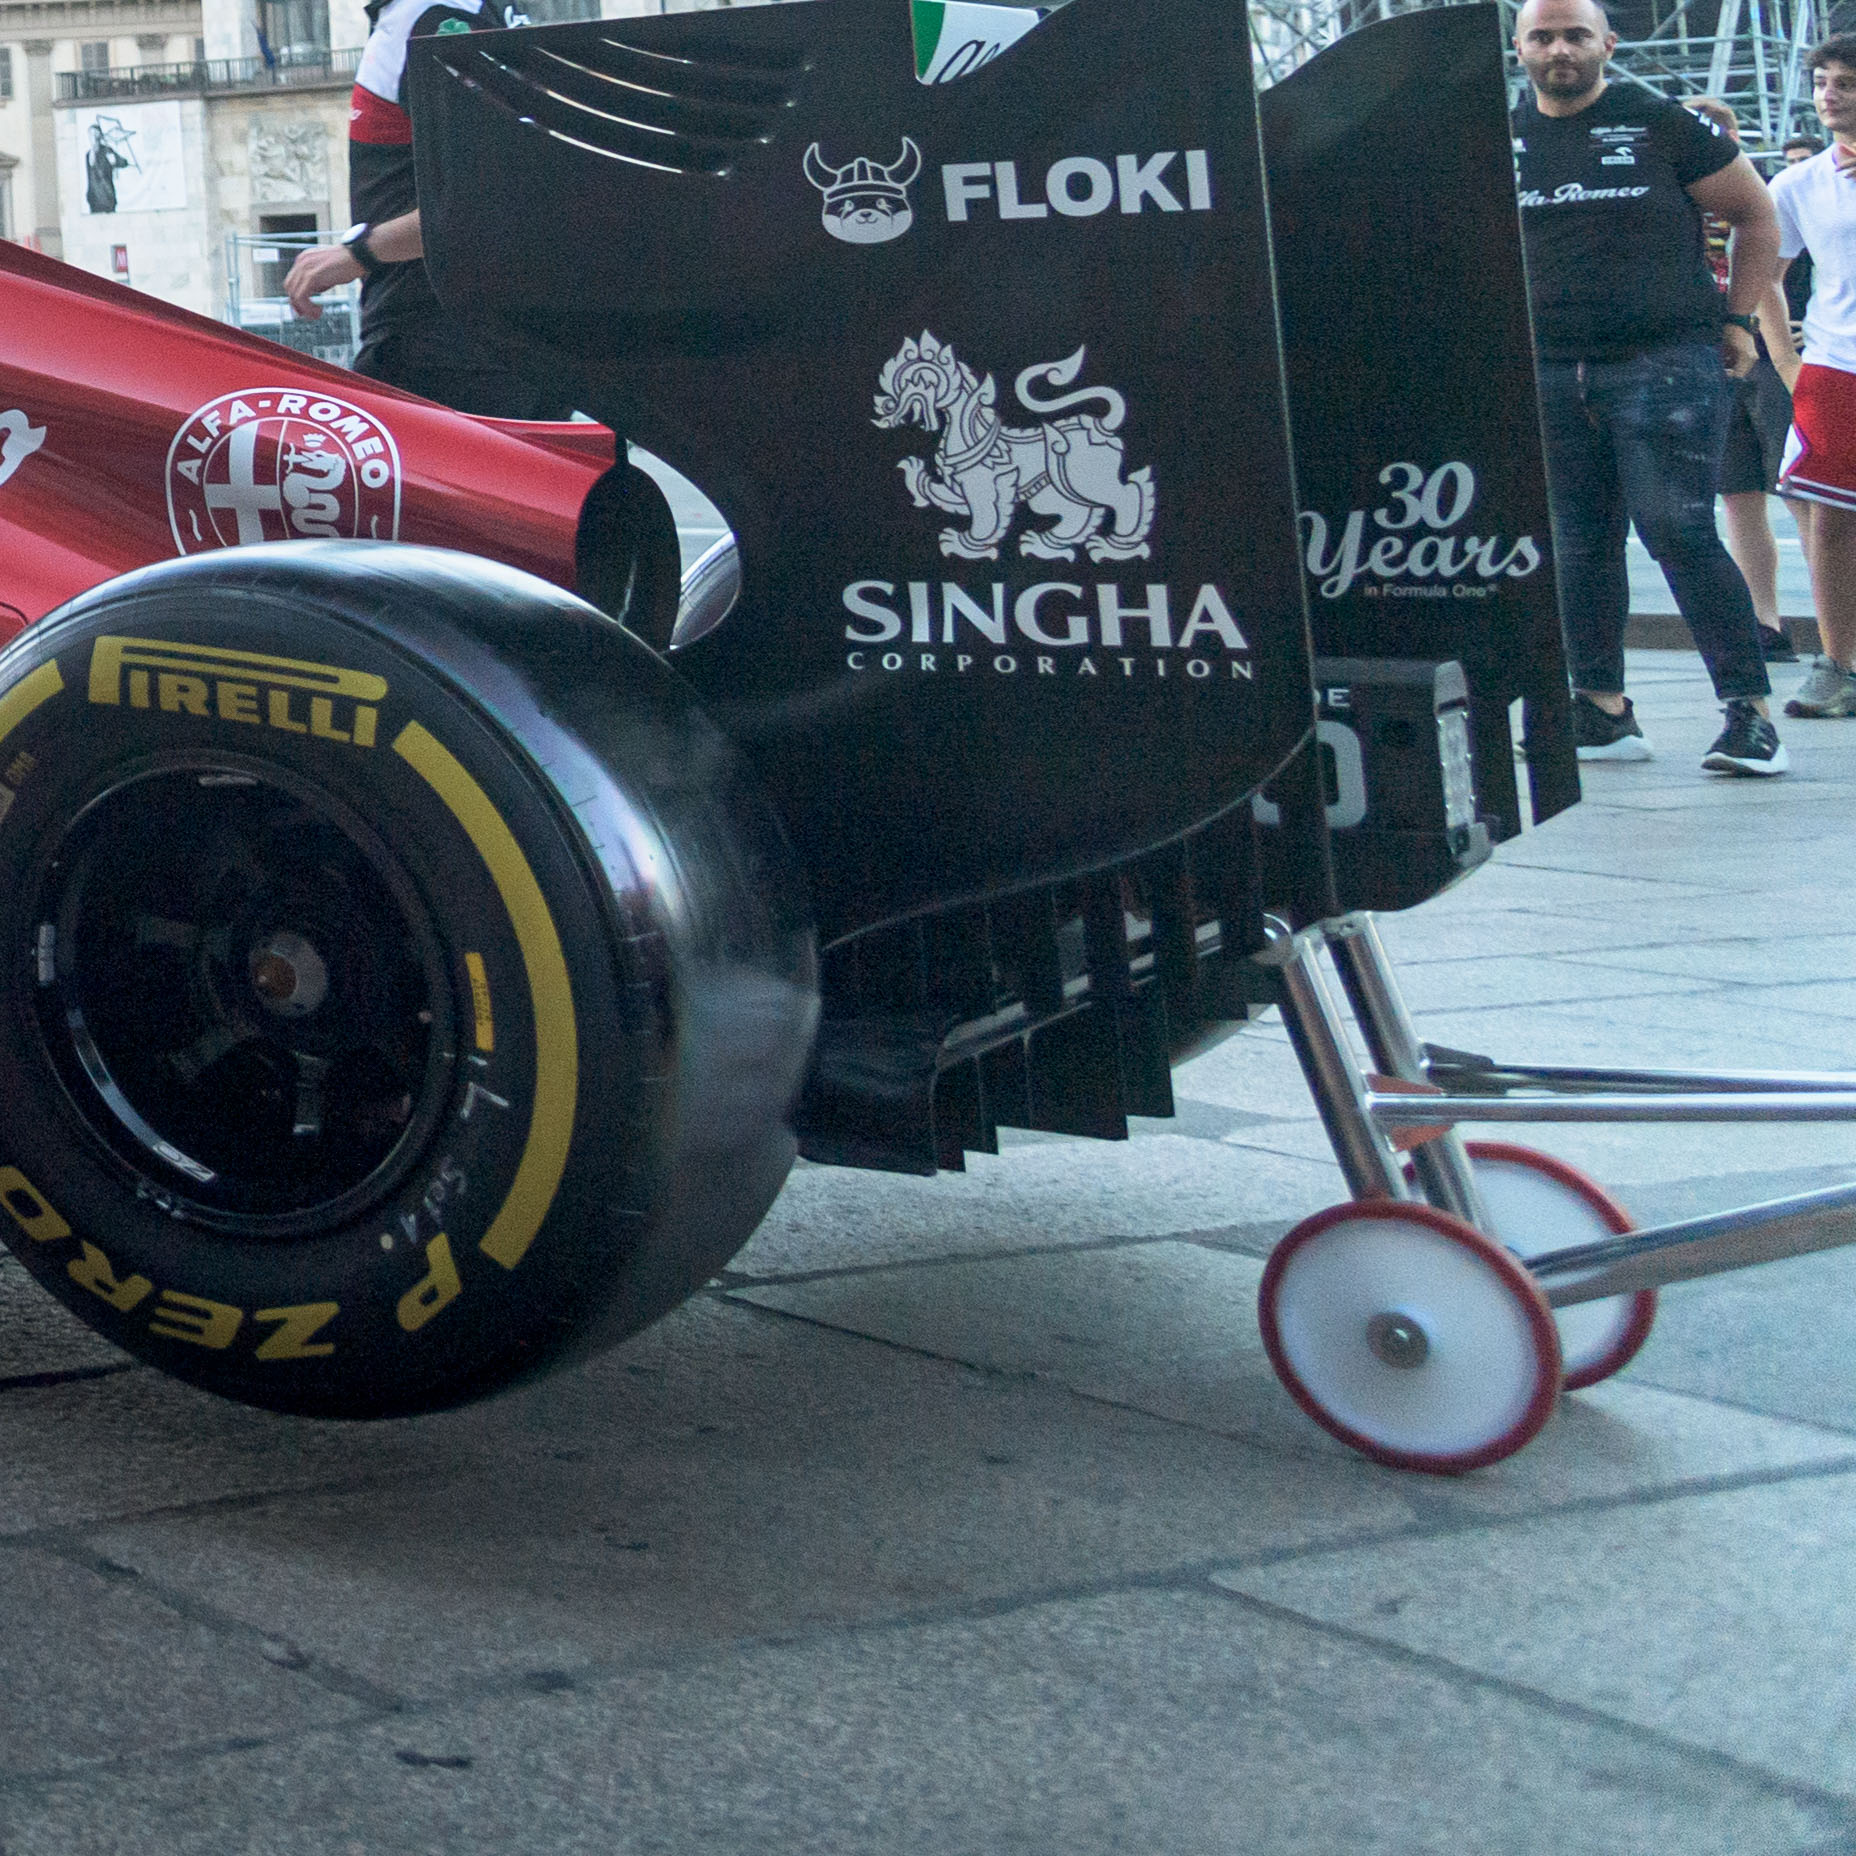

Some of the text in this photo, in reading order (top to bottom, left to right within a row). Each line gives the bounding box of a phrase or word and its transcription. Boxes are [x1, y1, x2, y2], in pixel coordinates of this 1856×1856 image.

[941, 149, 1212, 222] FLOKI
[1552, 183, 1650, 204] Romeo
[1373, 461, 1475, 529] 30
[1297, 510, 1540, 598] Years
[841, 579, 1248, 649] SINGHA
[1382, 583, 1447, 596] Formula
[88, 635, 388, 747] PIRELLI
[846, 651, 1253, 680] CORPORATION
[397, 1232, 463, 1333] P
